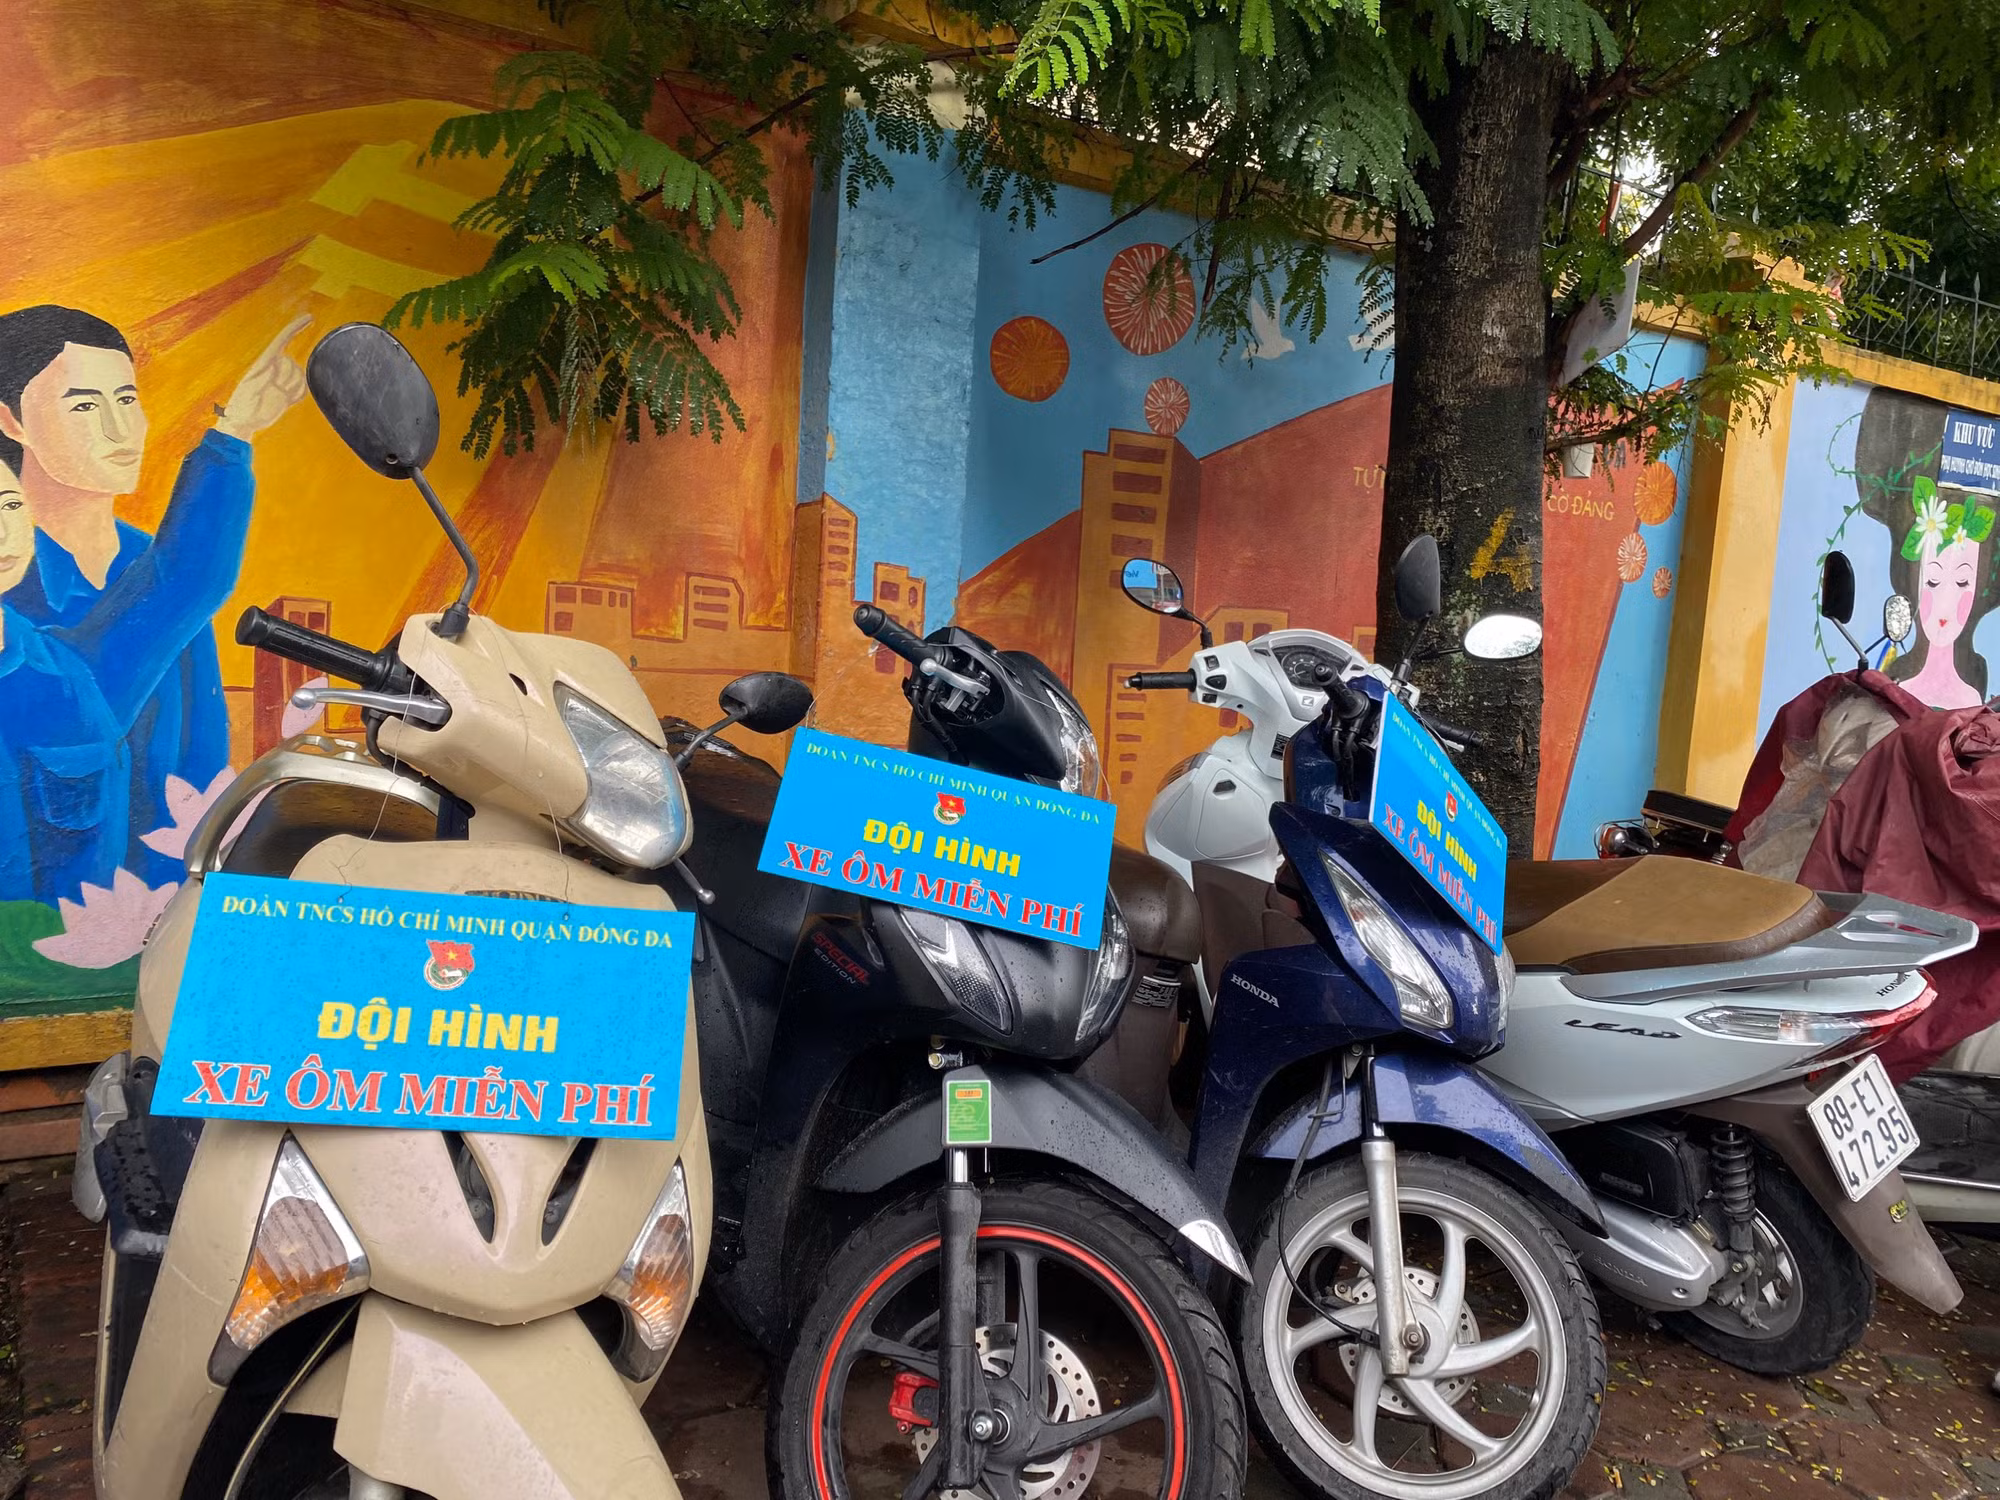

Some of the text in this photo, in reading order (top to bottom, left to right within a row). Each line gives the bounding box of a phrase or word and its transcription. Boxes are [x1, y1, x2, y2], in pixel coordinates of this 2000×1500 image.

[1953, 421, 1996, 454] KHU VỰC
[1547, 487, 1569, 513] CỜ
[1571, 490, 1615, 521] ĐẢNG
[949, 778, 988, 797] MINH
[862, 818, 1022, 878] ĐỘI HÌNH
[1416, 799, 1478, 883] ĐỘI HÌNH
[778, 841, 1086, 938] XE ÔM MIỄN PHÍ
[1382, 803, 1406, 845] XE
[1408, 825, 1435, 876] ÔM
[1474, 899, 1498, 947] PHÍ
[222, 894, 289, 918] ĐOÀN
[296, 901, 355, 924] TNCS
[398, 908, 441, 931] CHÍ
[446, 914, 506, 936] MINH
[644, 929, 673, 949] ĐA
[813, 931, 870, 985] SPECIAL
[814, 947, 857, 984] EDITION
[1230, 973, 1280, 1009] HONDA
[316, 996, 559, 1054] ĐỘI HÌNH
[1563, 1018, 1683, 1039] LEAD
[184, 1053, 655, 1127] XE ÔM MIỄN PHÍ
[1822, 1070, 1885, 1141] 89-E1
[1837, 1105, 1911, 1188] 472.95
